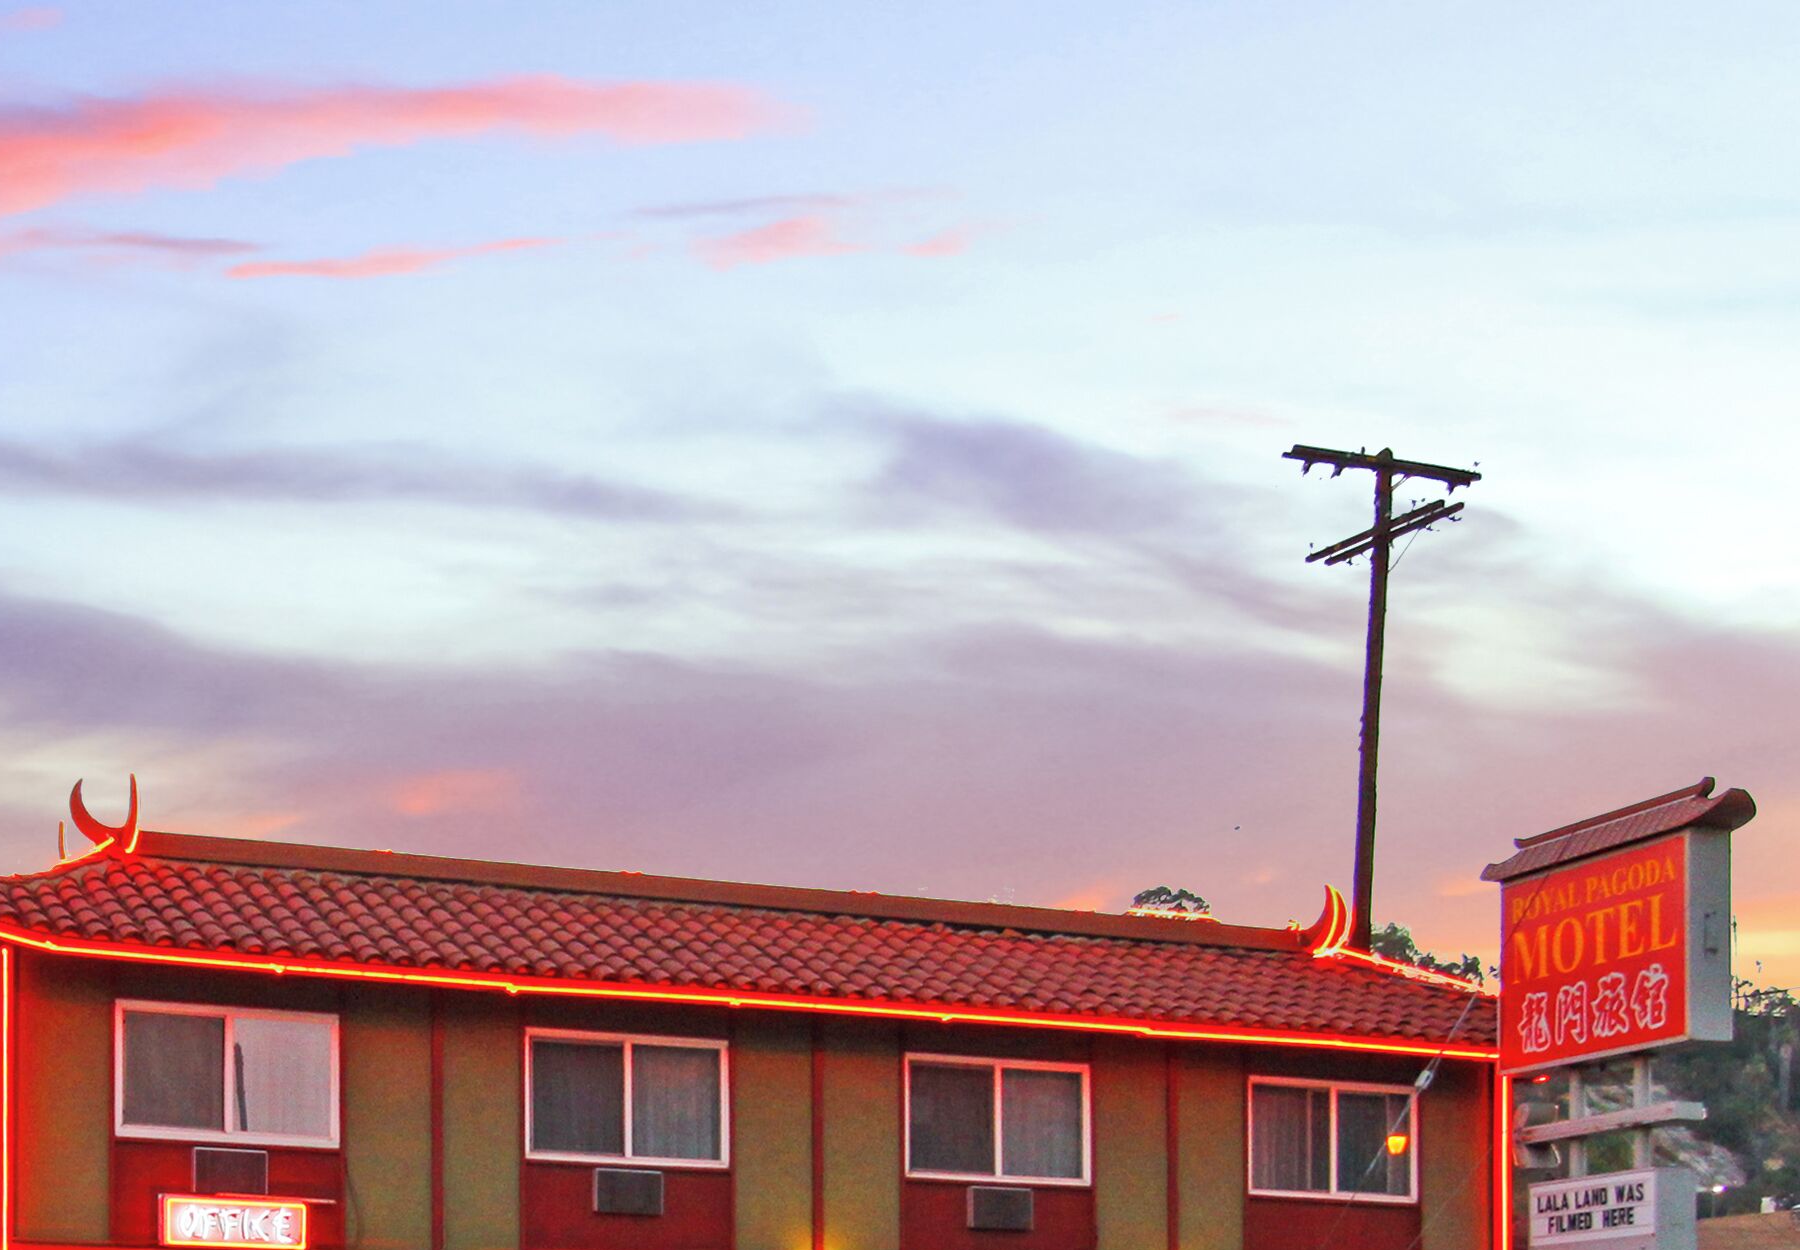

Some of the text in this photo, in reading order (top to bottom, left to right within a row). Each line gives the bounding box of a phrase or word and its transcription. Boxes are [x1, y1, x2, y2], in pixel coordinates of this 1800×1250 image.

[1511, 857, 1676, 924] ROYAL PAGODA
[1511, 893, 1677, 984] MOTEL
[1537, 1183, 1644, 1214] LALA LAND WAS
[178, 1204, 293, 1243] OFFICE
[1548, 1206, 1634, 1234] FILMED HERE
